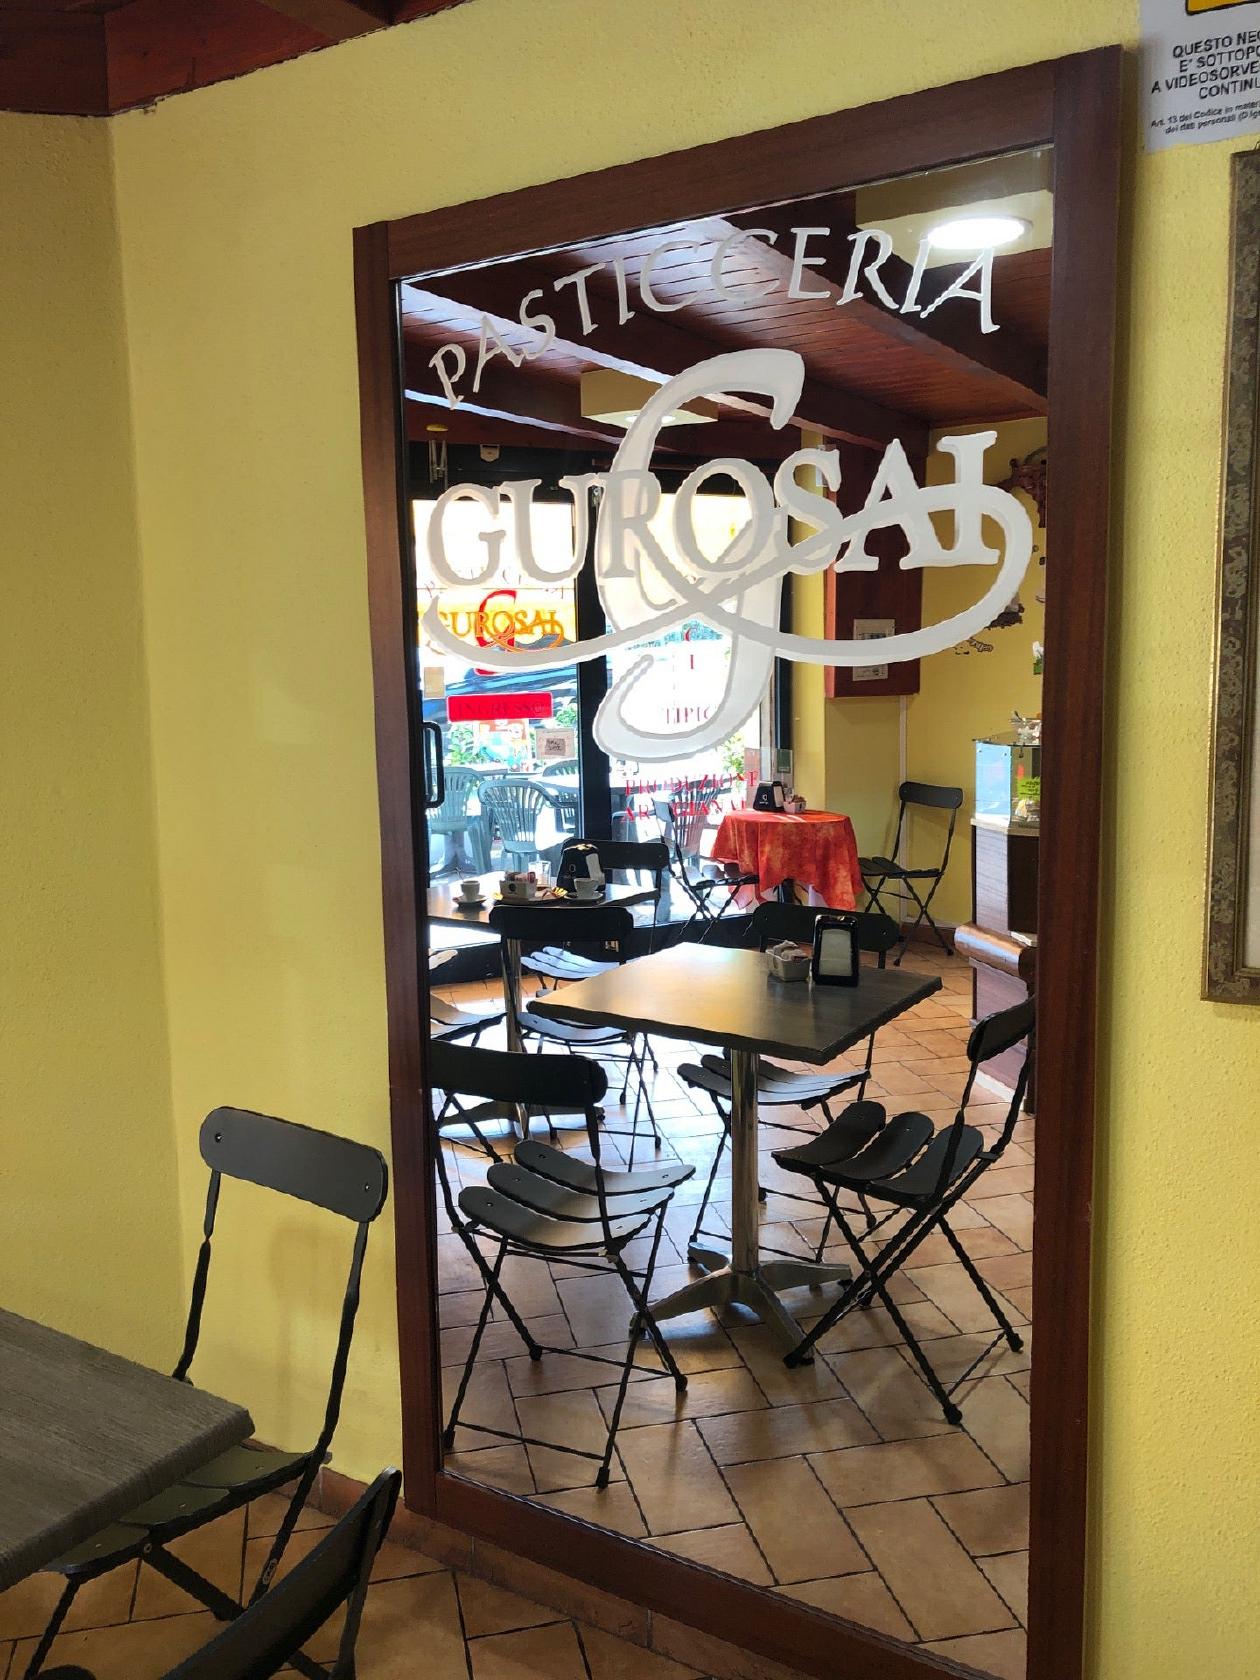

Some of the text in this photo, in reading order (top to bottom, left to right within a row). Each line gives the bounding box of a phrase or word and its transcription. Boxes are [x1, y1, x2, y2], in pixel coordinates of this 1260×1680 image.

[1173, 35, 1233, 58] QUESTO
[1151, 60, 1260, 94] A VIDEOSORVE
[1193, 107, 1222, 119] Codice
[428, 226, 1002, 412] PASTICCERIA
